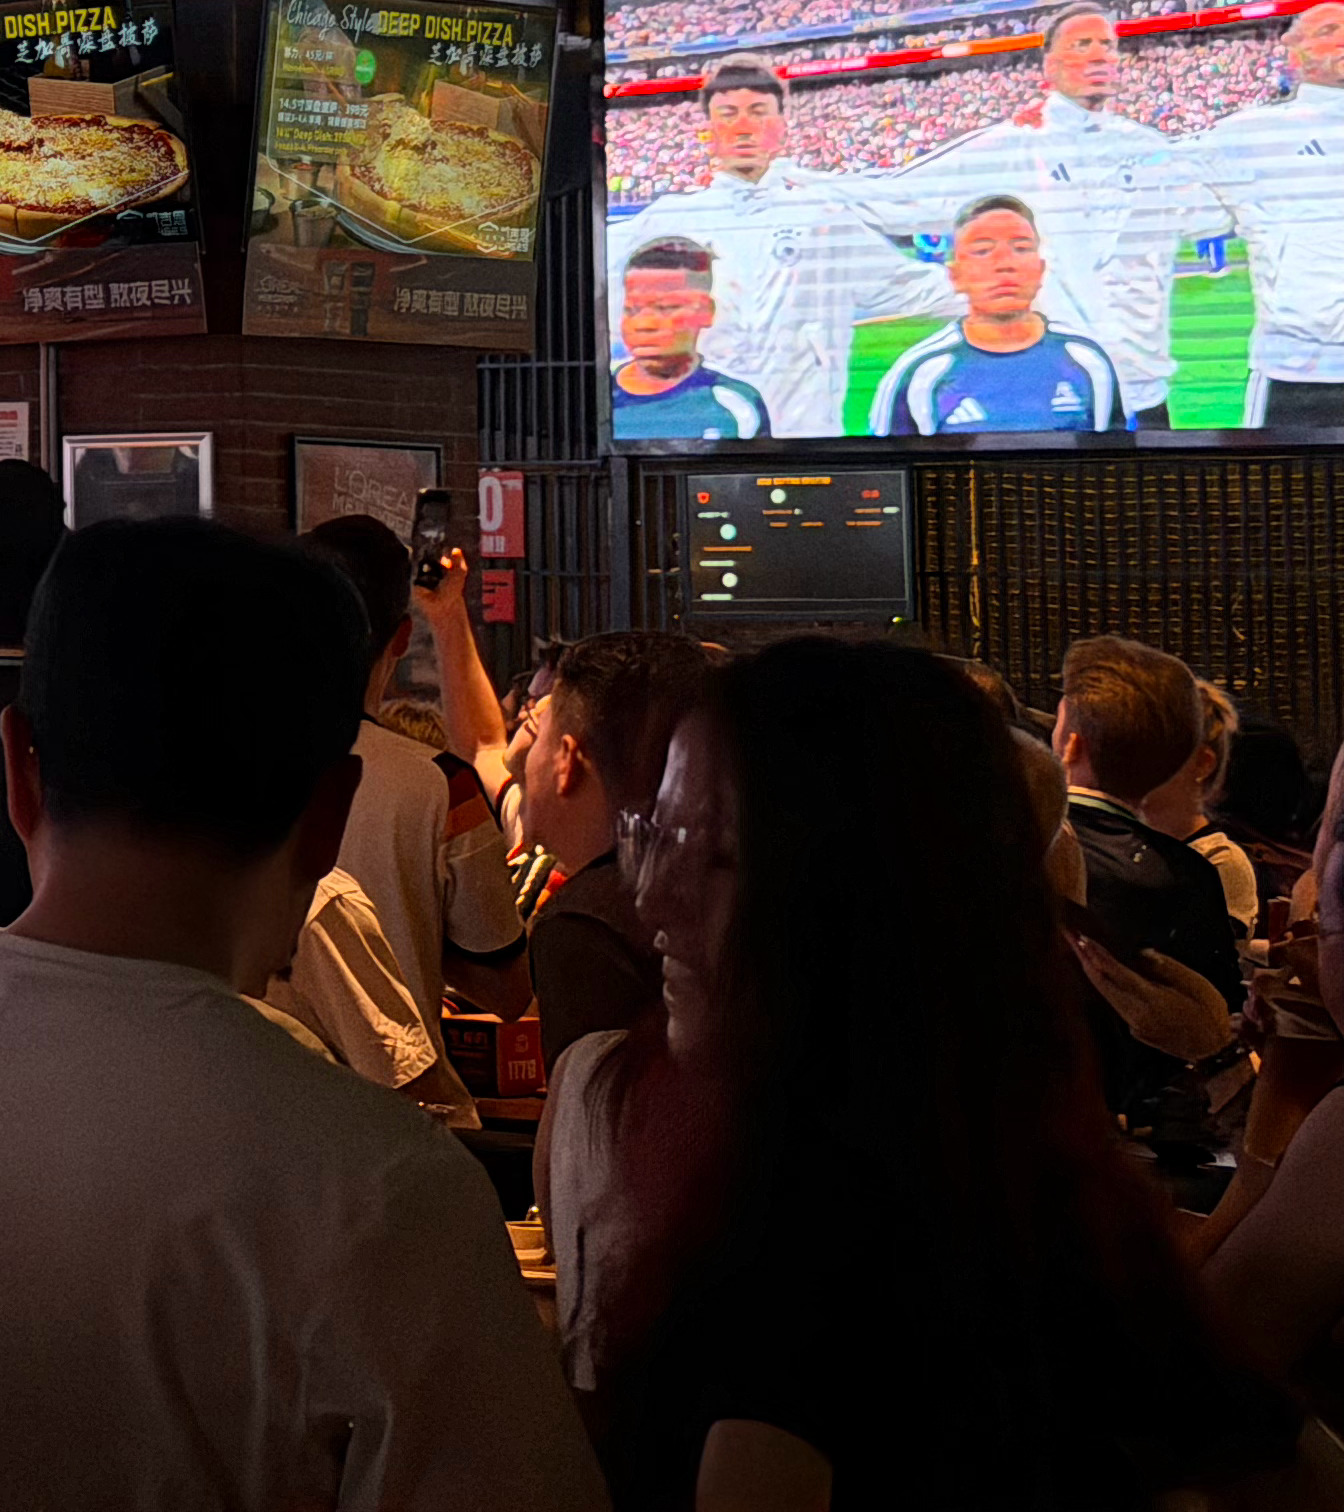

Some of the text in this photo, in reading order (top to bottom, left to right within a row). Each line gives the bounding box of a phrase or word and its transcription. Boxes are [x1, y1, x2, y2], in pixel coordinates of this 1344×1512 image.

[4, 11, 54, 38] DISH
[56, 5, 117, 35] PIZZA
[341, 4, 376, 43] Style
[377, 10, 421, 37] DEEP
[424, 15, 462, 41] DISH
[466, 20, 513, 47] PIZZA
[23, 284, 106, 313] 净爽有型
